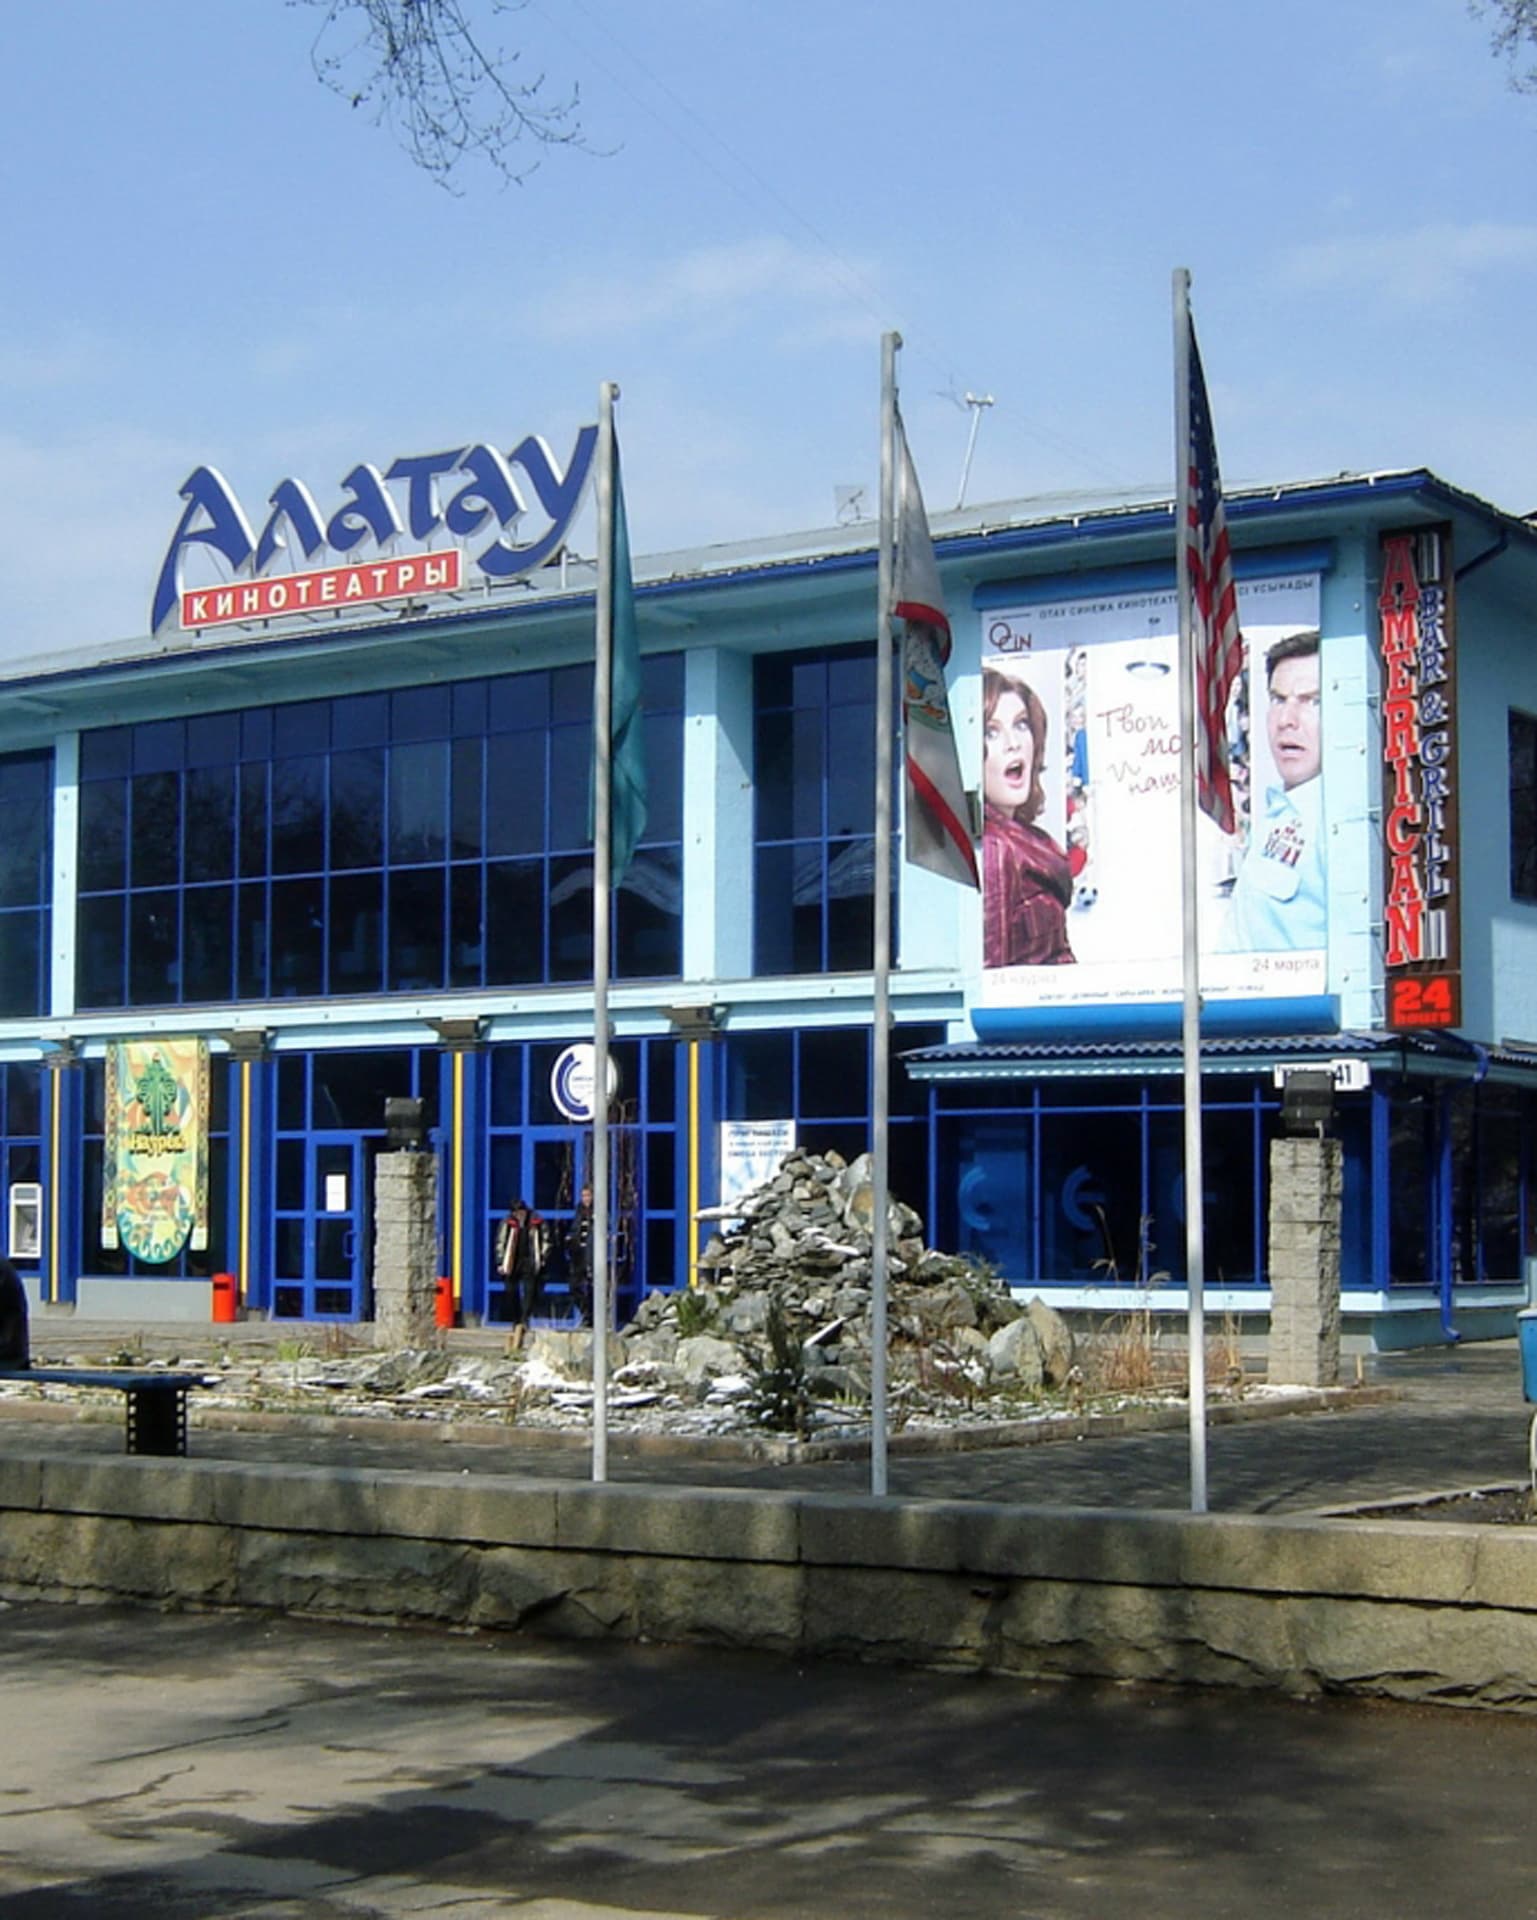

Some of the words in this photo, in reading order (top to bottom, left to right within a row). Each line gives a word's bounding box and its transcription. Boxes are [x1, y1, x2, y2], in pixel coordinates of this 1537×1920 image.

[151, 424, 600, 637] Алатау
[191, 557, 449, 621] КИНОТЕАТРЫ
[1419, 585, 1447, 684] BAR
[1096, 703, 1169, 737] Твои
[1420, 692, 1449, 725] &
[1140, 734, 1199, 756] мо
[1379, 535, 1424, 967] AMERICAN
[1128, 772, 1192, 794] наш
[1420, 731, 1450, 899] GRILL
[1252, 957, 1270, 973] 24
[1274, 957, 1321, 974] марта
[1393, 978, 1451, 1010] 24
